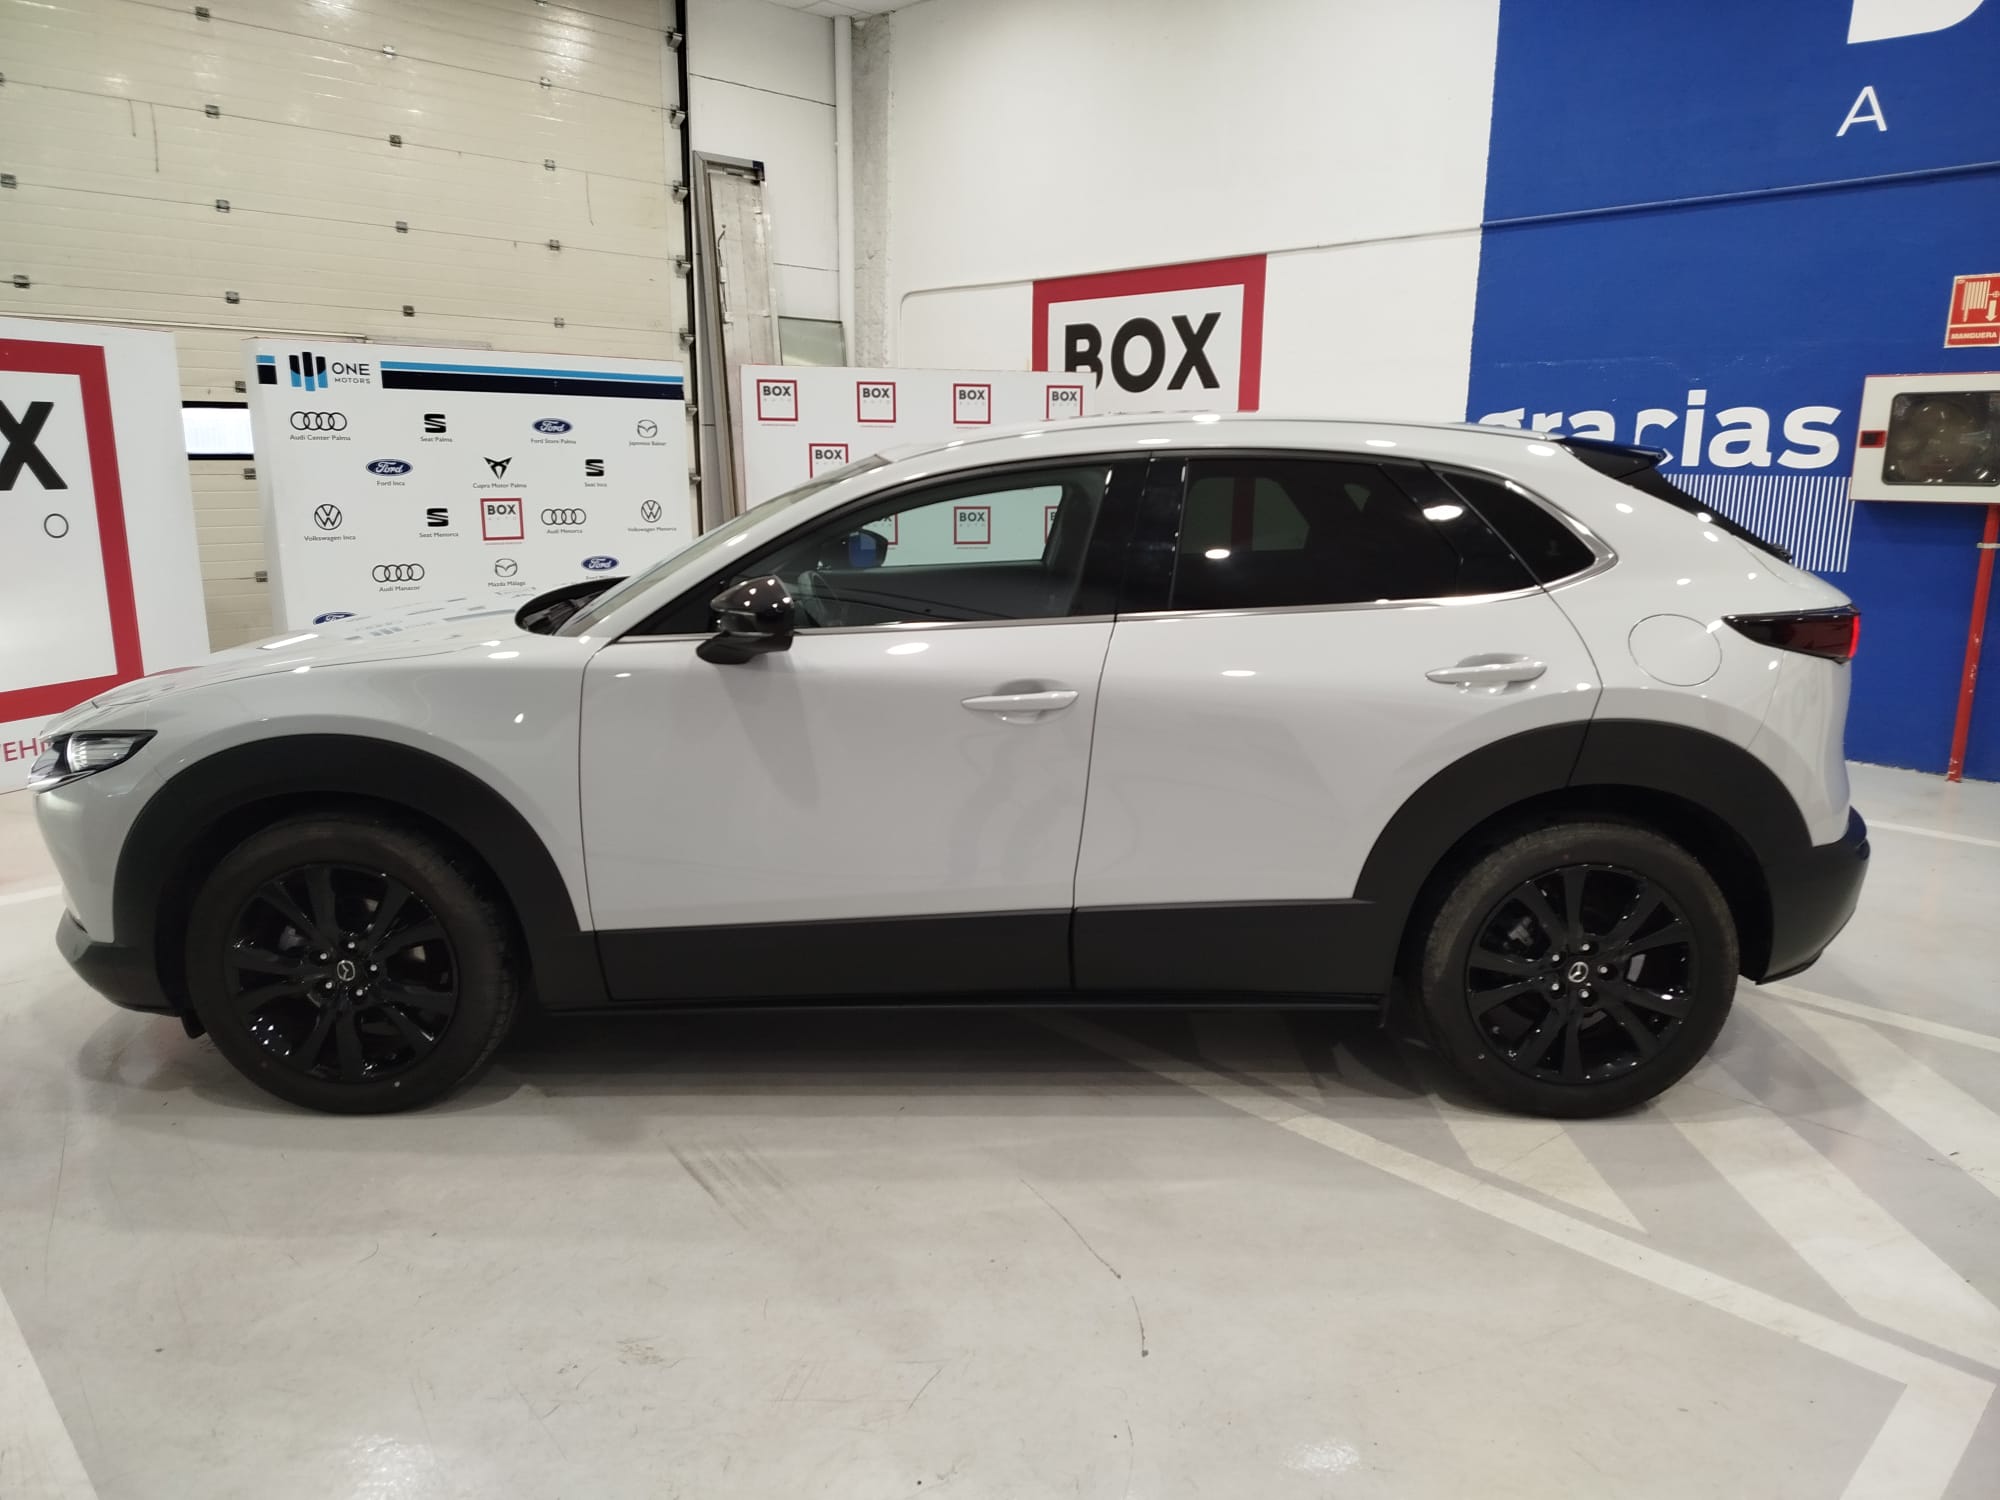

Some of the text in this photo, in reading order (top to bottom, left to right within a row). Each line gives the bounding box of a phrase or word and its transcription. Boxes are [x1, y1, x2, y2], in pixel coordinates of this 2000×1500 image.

[1064, 312, 1222, 393] BOX
[331, 362, 371, 376] ONE
[762, 386, 792, 397] BOX
[862, 387, 890, 398] BOX
[958, 389, 986, 401] BOX
[1051, 391, 1078, 402] BOX
[540, 421, 565, 432] Ford
[814, 449, 843, 461] BOX
[375, 461, 403, 474] Ford
[486, 504, 517, 516] BOX
[959, 512, 986, 523] BOX
[304, 535, 342, 543] Volkswagen
[588, 558, 612, 569] Ford
